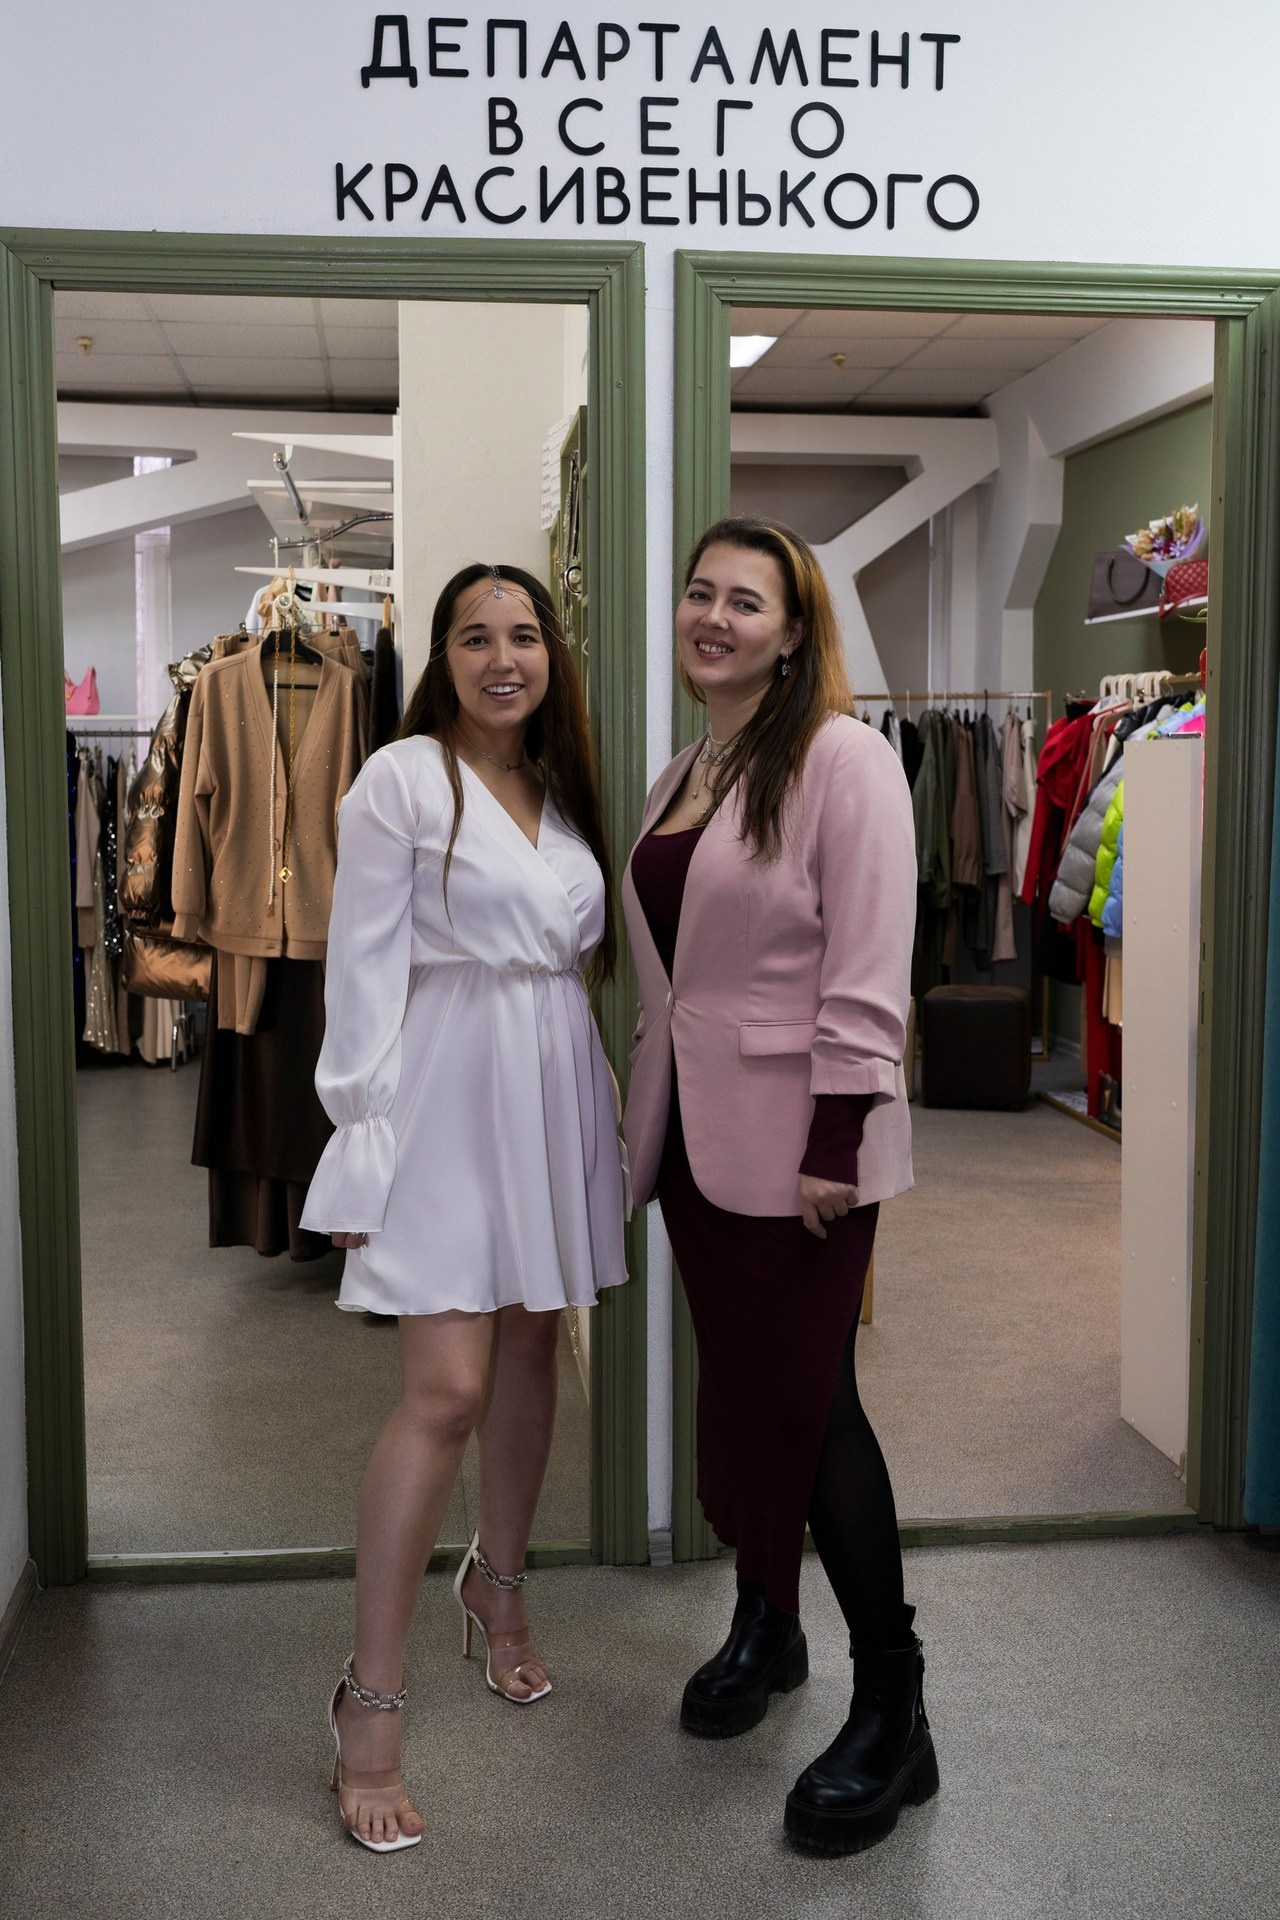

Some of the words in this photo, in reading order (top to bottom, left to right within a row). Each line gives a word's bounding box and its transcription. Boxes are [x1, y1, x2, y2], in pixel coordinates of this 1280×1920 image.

[360, 14, 961, 92] ДЕПАРТАМЕНТ
[487, 96, 845, 159] ВСЕГО
[335, 162, 980, 231] КРАСИВЕНЬКОГО
